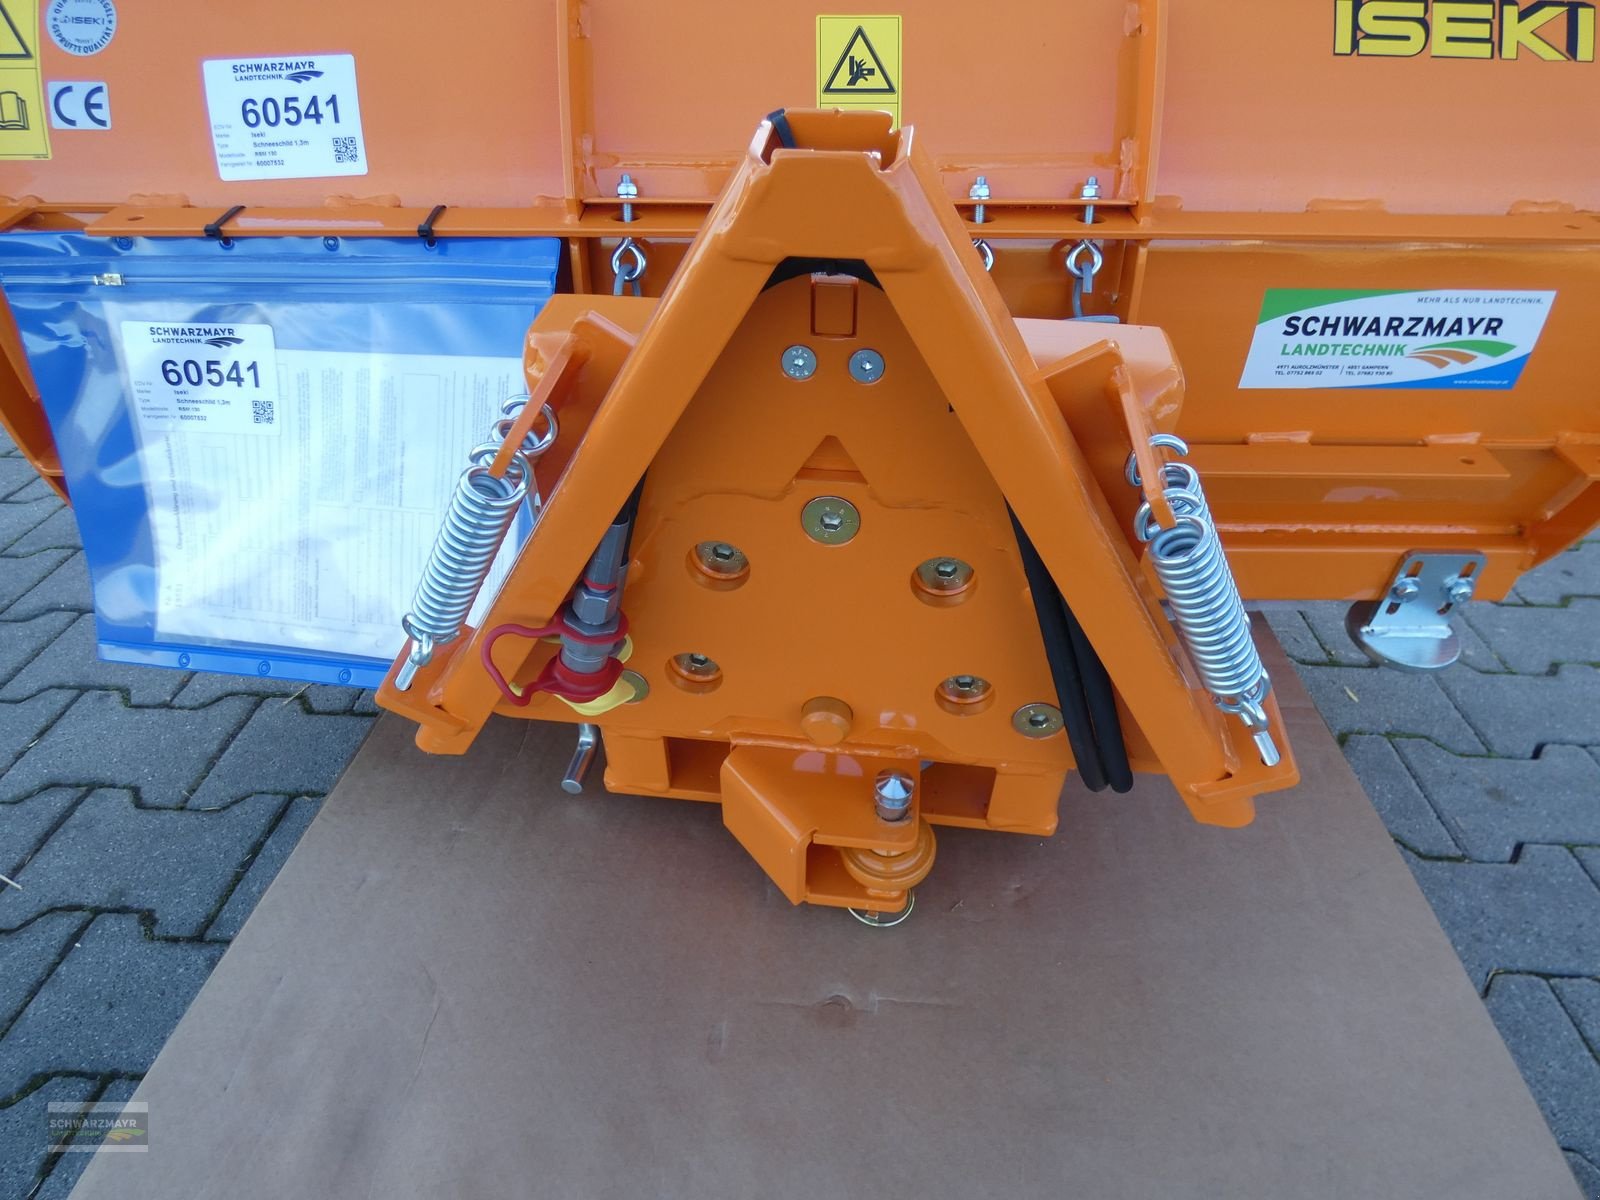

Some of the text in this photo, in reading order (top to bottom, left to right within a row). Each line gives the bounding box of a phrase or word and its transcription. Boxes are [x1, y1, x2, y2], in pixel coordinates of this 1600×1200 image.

[71, 16, 105, 25] ISEKI
[1333, 0, 1595, 62] ISEKI
[232, 61, 315, 73] SCHWARZMAYR
[235, 73, 284, 82] LANDTECHNIK
[54, 85, 108, 127] CE
[241, 94, 340, 128] 60541
[253, 139, 293, 148] Schneeschild
[1417, 296, 1441, 304] MEHR
[1443, 296, 1460, 304] ALS
[149, 326, 236, 337] SCHWARZMAYR
[1282, 315, 1504, 337] SCHWARZMAYR
[1280, 343, 1408, 357] LANDTECHNIK
[161, 359, 260, 388] 60541
